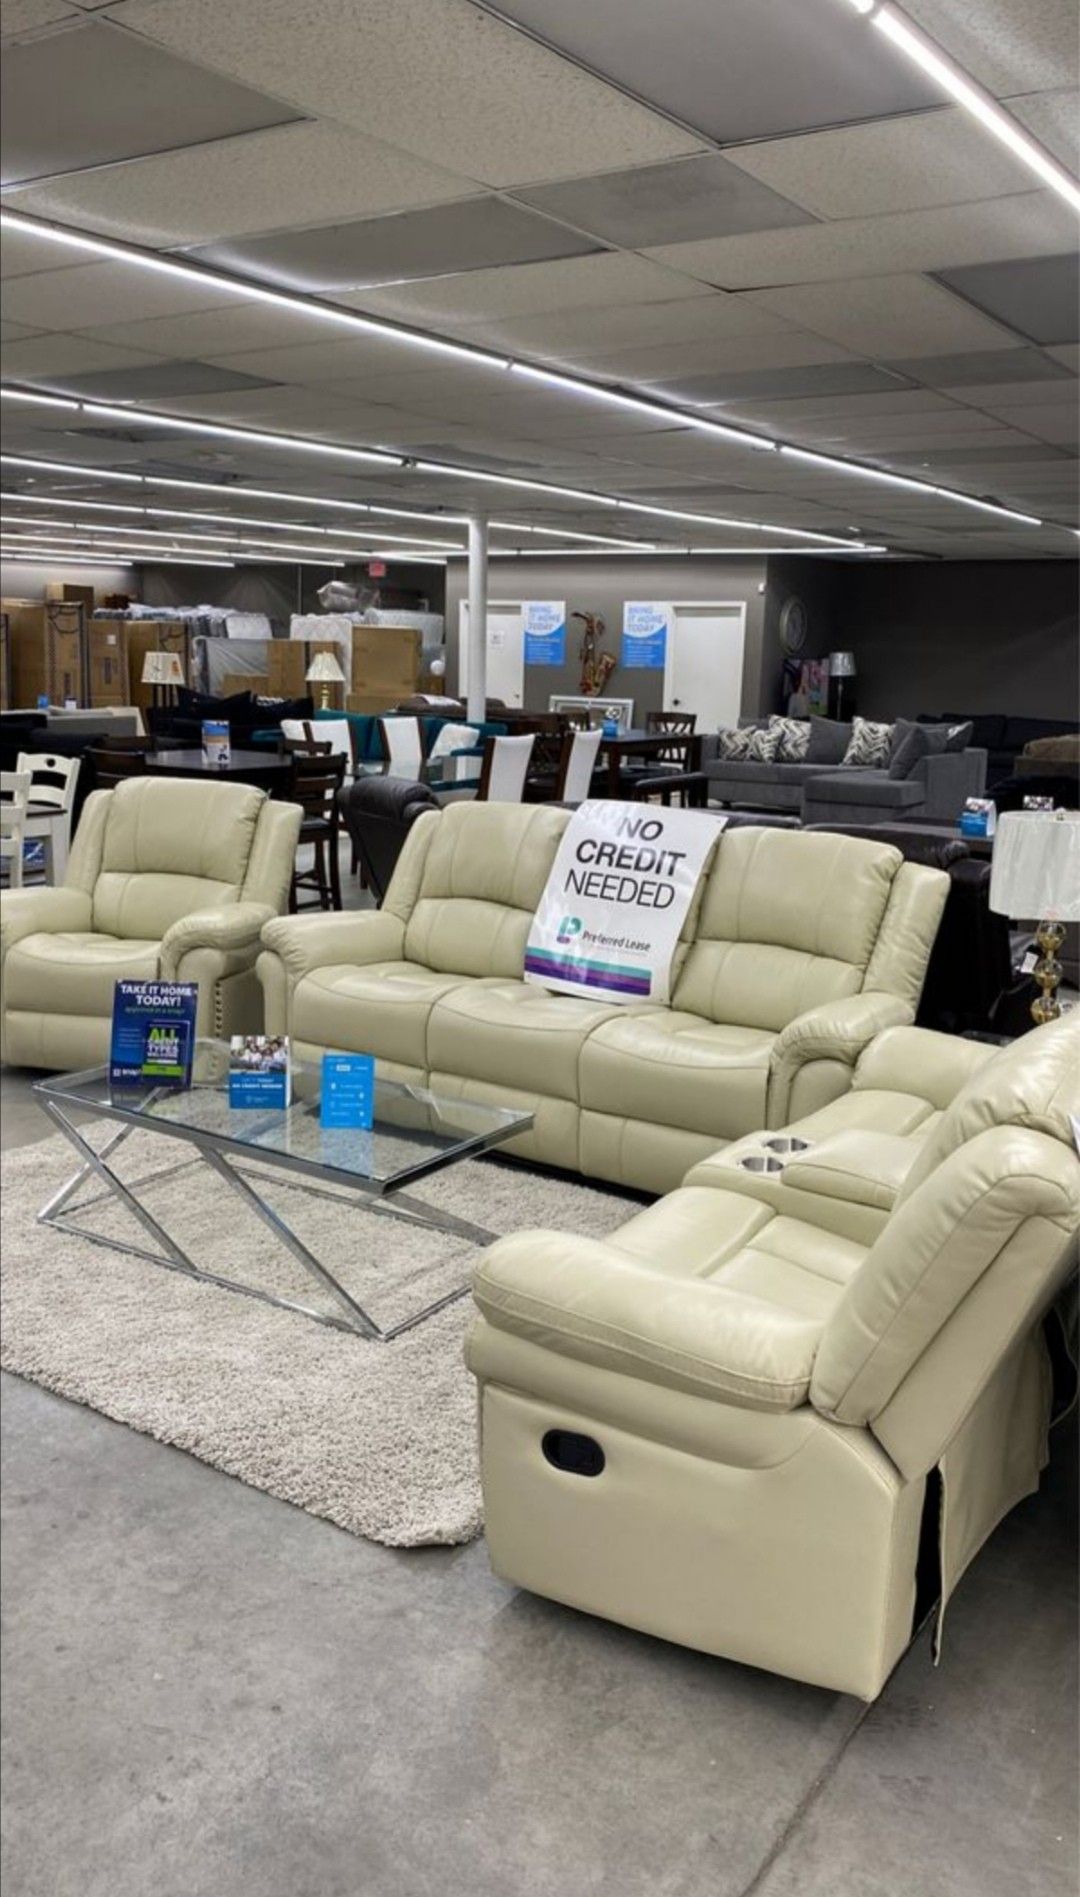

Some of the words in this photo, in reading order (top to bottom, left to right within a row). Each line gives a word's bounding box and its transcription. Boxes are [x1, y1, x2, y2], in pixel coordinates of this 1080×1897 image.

[616, 816, 664, 841] NO
[576, 838, 686, 876] CREDIT
[564, 868, 675, 909] NEEDED
[582, 930, 625, 947] Preferred
[625, 939, 651, 951] Lease
[121, 985, 147, 994] TAKE
[149, 985, 159, 995] IT
[161, 987, 192, 996] HOME
[136, 995, 182, 1006] TODAY!
